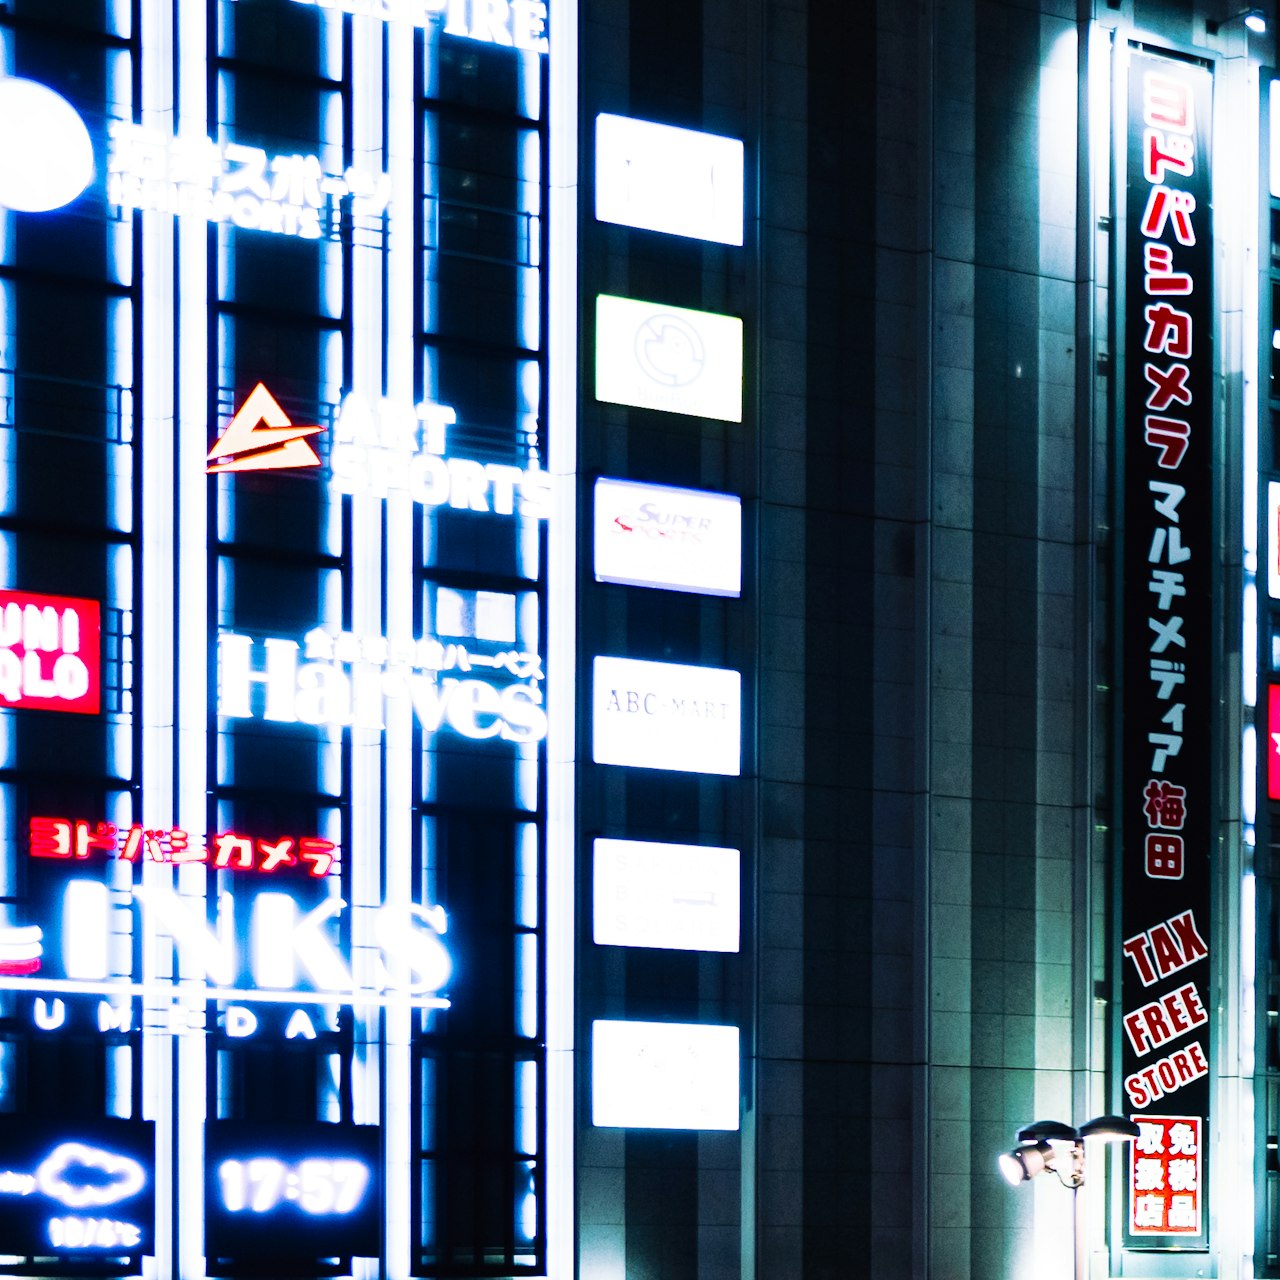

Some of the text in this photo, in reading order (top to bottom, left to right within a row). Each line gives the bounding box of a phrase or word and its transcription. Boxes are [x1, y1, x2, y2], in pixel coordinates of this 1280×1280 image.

[331, 444, 555, 519] SPORTS
[220, 633, 549, 744] Harves
[32, 816, 341, 878] ヨドバシカメラ
[1124, 910, 1208, 986] TAX
[34, 997, 318, 1041] UMEDA
[1124, 982, 1208, 1057] FREE
[1125, 1041, 1208, 1109] STORE
[221, 1160, 366, 1211] 17:57
